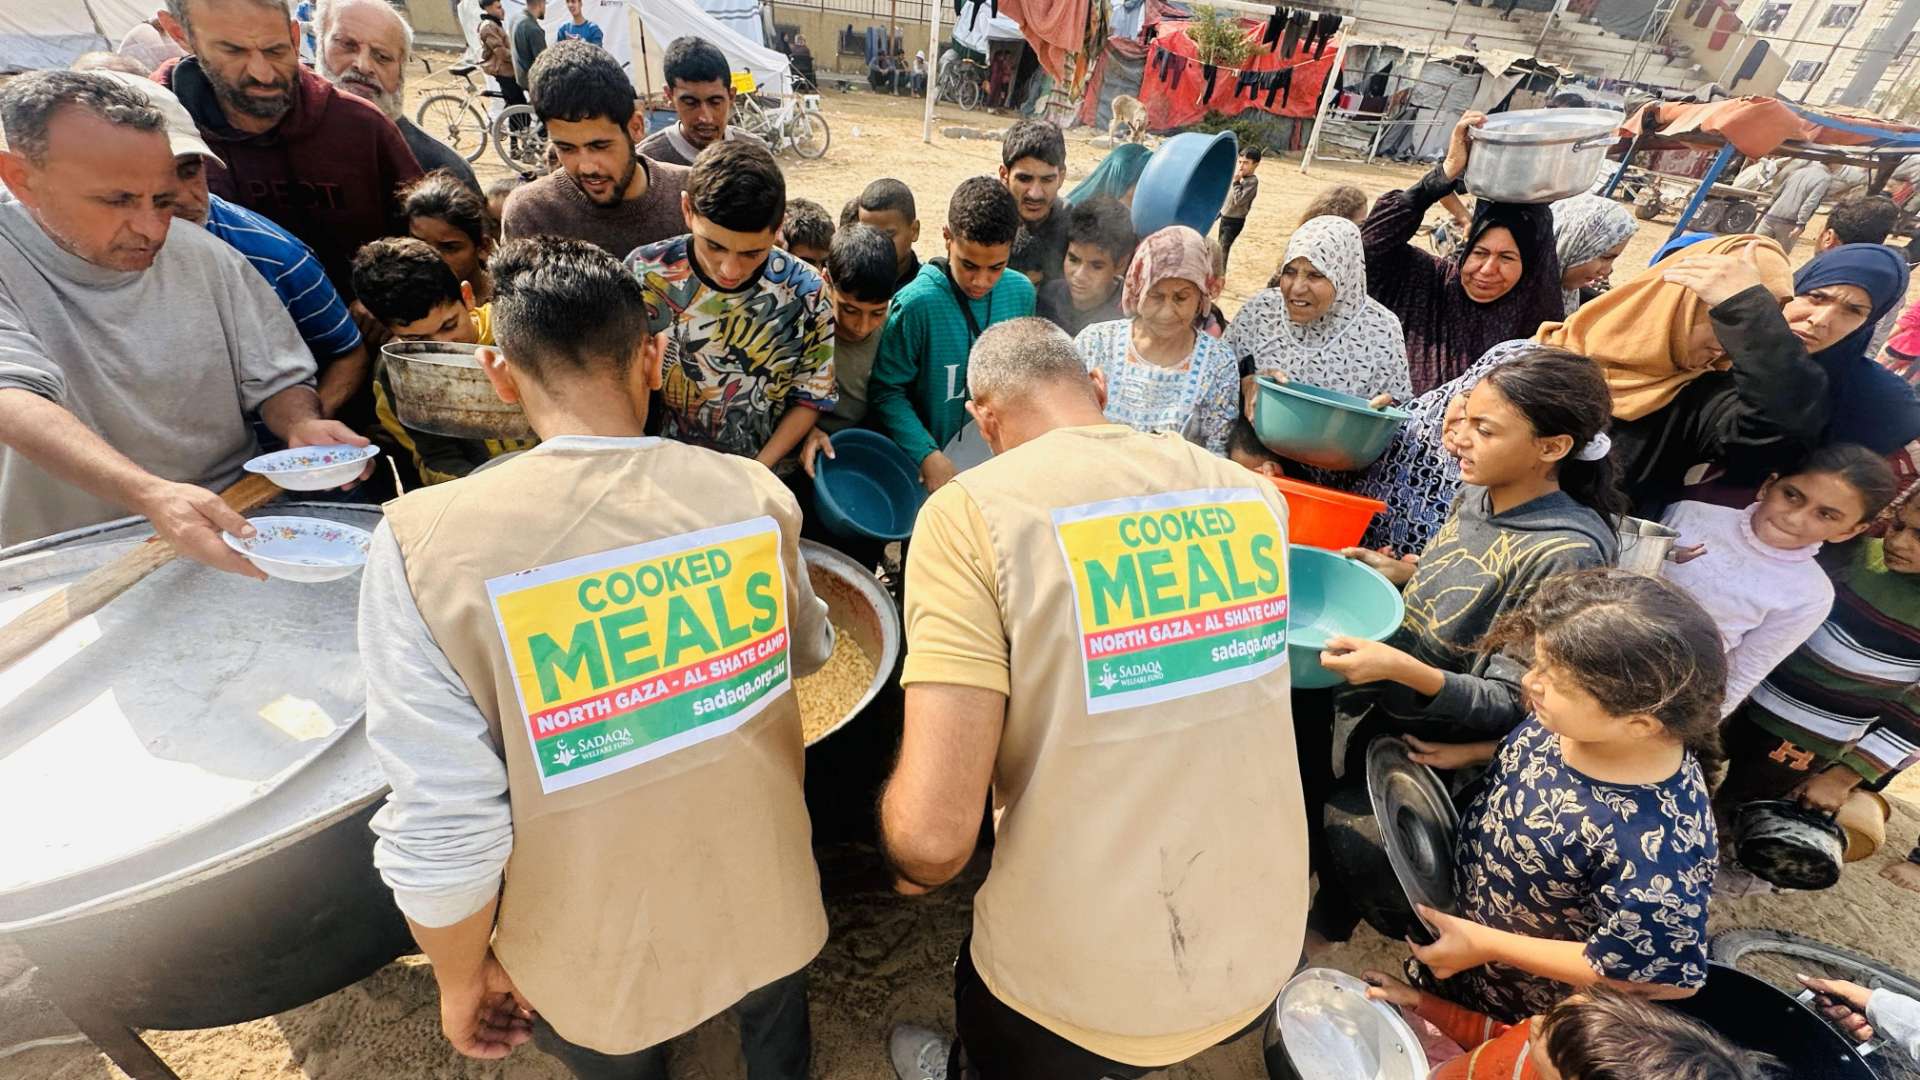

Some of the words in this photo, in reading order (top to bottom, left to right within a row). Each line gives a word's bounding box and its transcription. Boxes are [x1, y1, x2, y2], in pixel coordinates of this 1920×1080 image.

[944, 364, 966, 403] L
[1119, 507, 1236, 548] COOKED
[577, 547, 732, 612] COOKED
[1084, 533, 1280, 626] MEALS
[528, 571, 778, 704] MEALS
[1090, 629, 1149, 655] NORTH
[1150, 619, 1193, 642] GAZA
[1204, 615, 1224, 632] AL
[1225, 604, 1264, 628] SHATE
[1263, 599, 1286, 619] CAMP
[537, 696, 612, 734] NORTH
[615, 678, 669, 709] GAZA
[683, 668, 707, 688] AL
[711, 648, 757, 679] SHATE
[757, 632, 785, 661] CAMP
[692, 659, 785, 717] sadaqa.org.au
[1119, 659, 1162, 677] SADAQA
[578, 727, 632, 752] SADAQA
[581, 743, 614, 762] WELFARE
[613, 737, 634, 752] FUND
[1768, 738, 1815, 771] H
